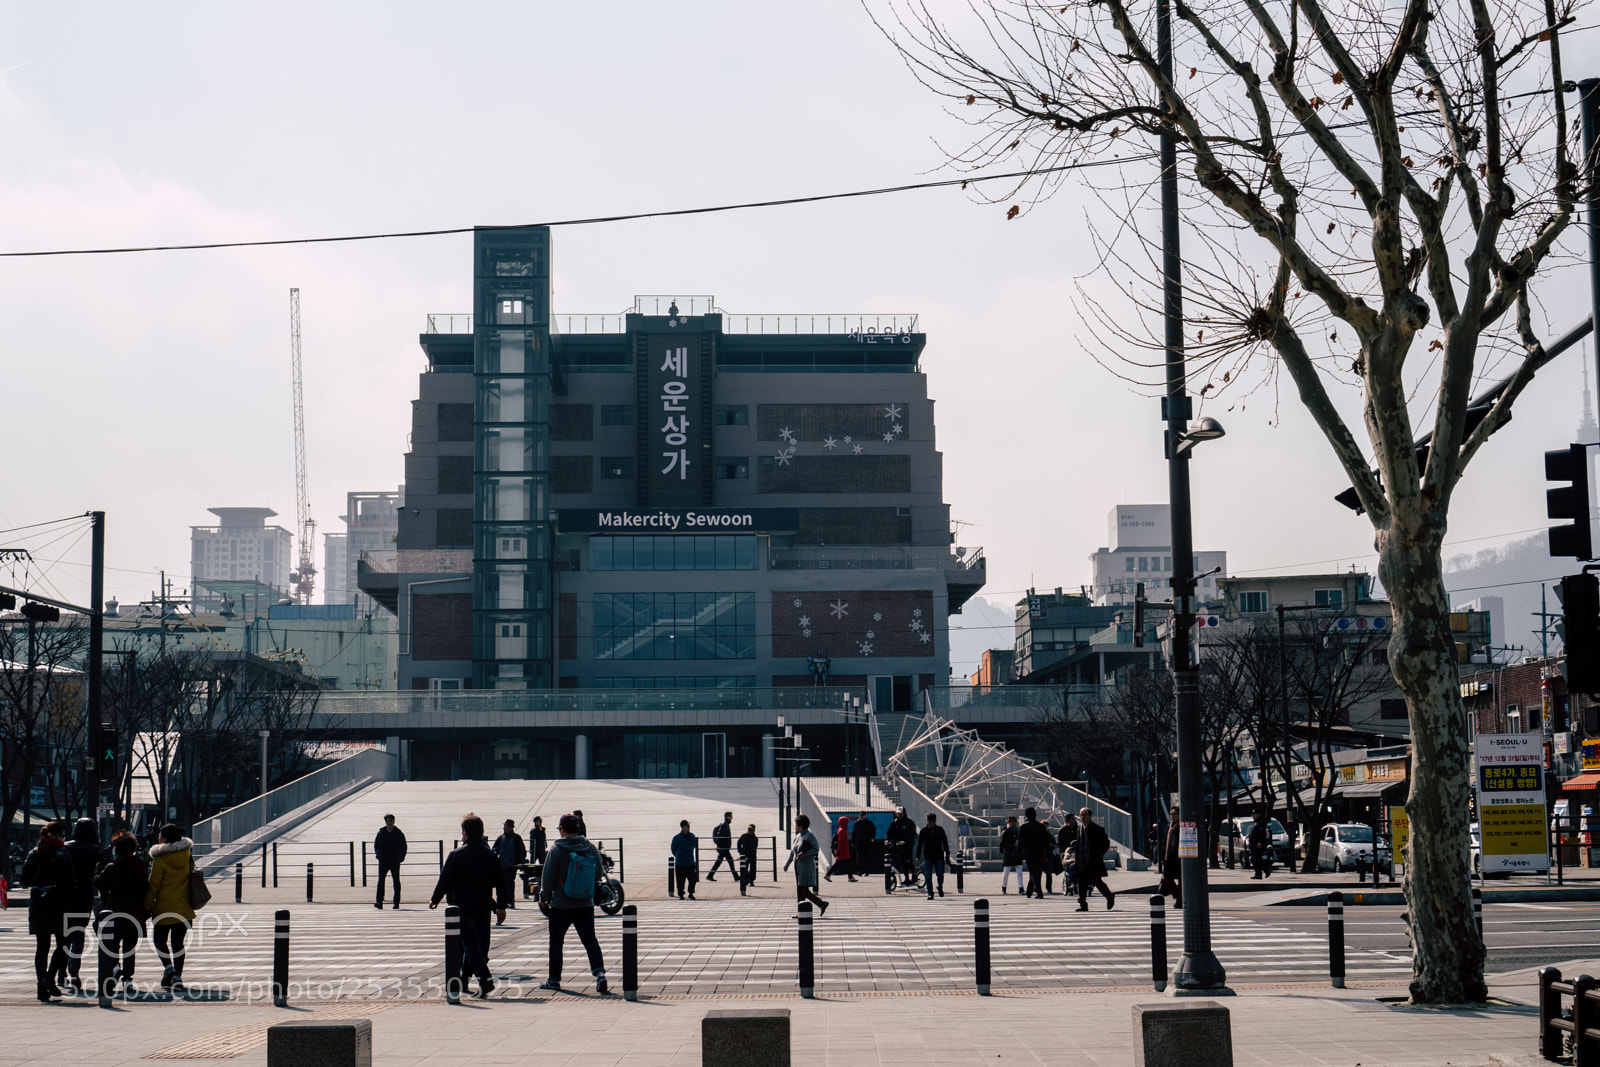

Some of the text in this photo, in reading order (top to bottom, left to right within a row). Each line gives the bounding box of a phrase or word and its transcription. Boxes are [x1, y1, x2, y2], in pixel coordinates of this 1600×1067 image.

[848, 326, 912, 344] 세운옥상
[660, 347, 690, 480] 세운상가
[598, 511, 752, 530] Makercity Sewoon
[1520, 767, 1537, 778] 종묘
